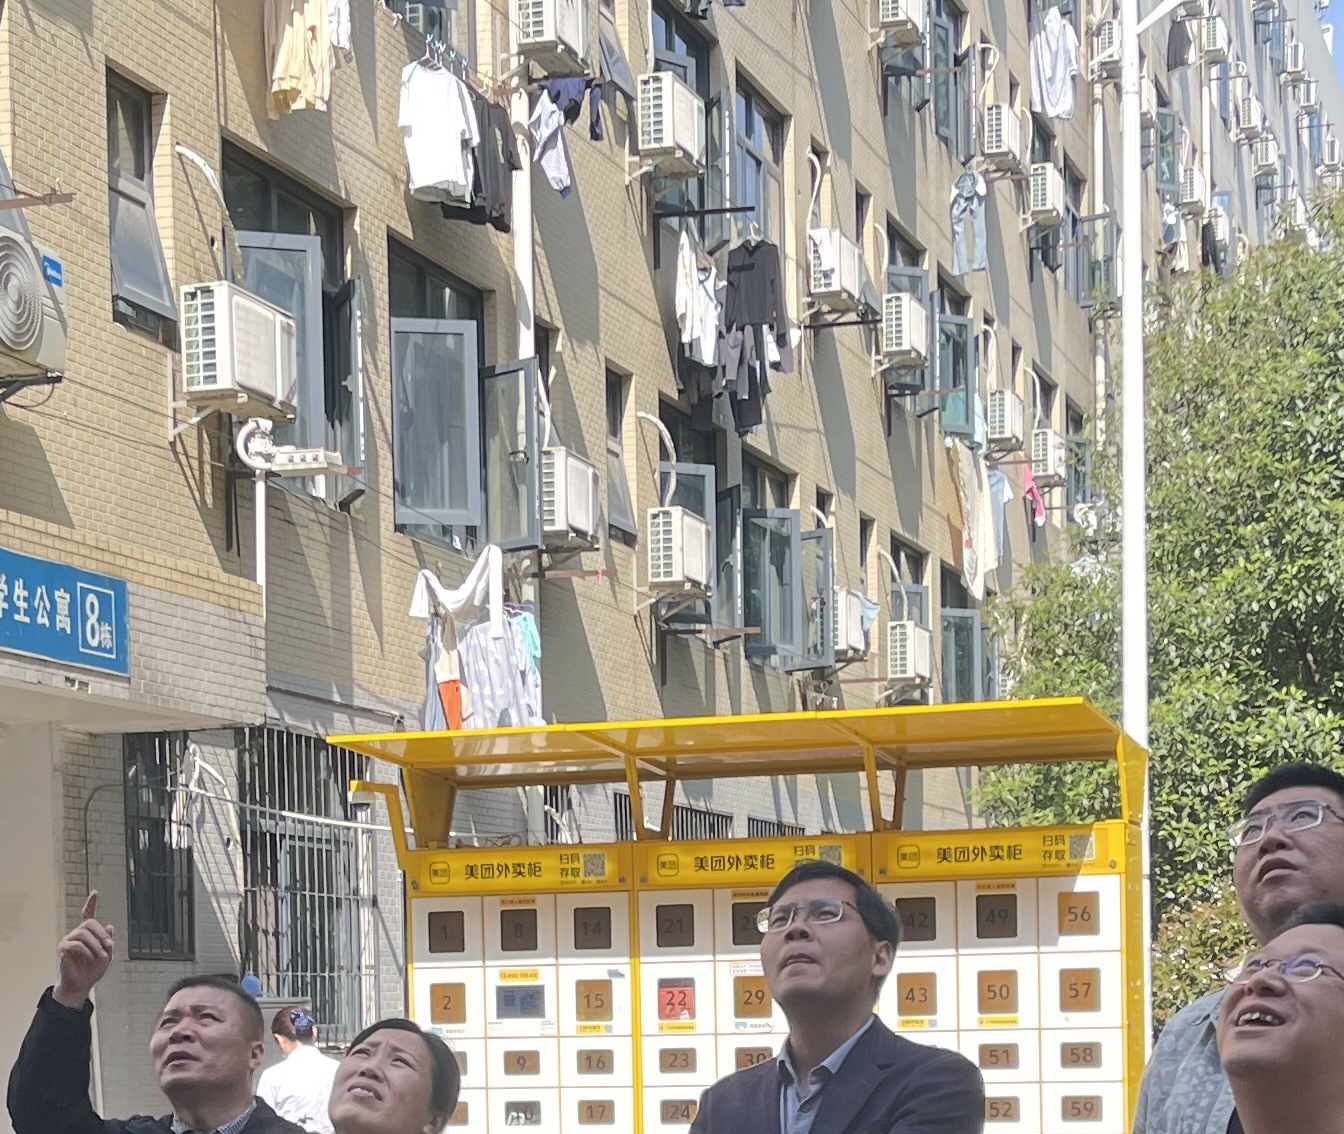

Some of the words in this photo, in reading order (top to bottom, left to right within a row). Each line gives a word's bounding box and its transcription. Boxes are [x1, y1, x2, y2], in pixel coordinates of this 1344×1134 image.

[85, 593, 113, 649] 8栋
[1042, 835, 1066, 847] 扫码
[793, 845, 816, 856] 扫码
[936, 844, 1023, 864] 美团外卖柜
[1042, 849, 1066, 861] 存取
[559, 853, 581, 865] 扫码
[694, 853, 776, 872] 美团外卖柜
[464, 862, 542, 880] 美团外卖柜
[559, 867, 581, 878] 存取
[906, 912, 928, 928] 42
[985, 909, 1009, 924] 49
[1067, 905, 1091, 922] 56
[581, 920, 602, 935] 14
[664, 917, 684, 934] 21
[743, 989, 765, 1005] 29
[906, 987, 928, 1003] 43
[987, 984, 1010, 1000] 50
[1068, 982, 1092, 998] 57
[442, 995, 452, 1010] 2
[584, 993, 604, 1008] 15
[666, 990, 687, 1006] 22
[586, 1055, 606, 1069] 16
[668, 1053, 690, 1068] 23
[989, 1049, 1010, 1064] 51
[1070, 1047, 1094, 1063] 58
[516, 1056, 527, 1070] 9
[586, 1105, 606, 1120] 17
[669, 1105, 691, 1119] 24
[989, 1101, 1012, 1118] 52
[1071, 1101, 1094, 1117] 59
